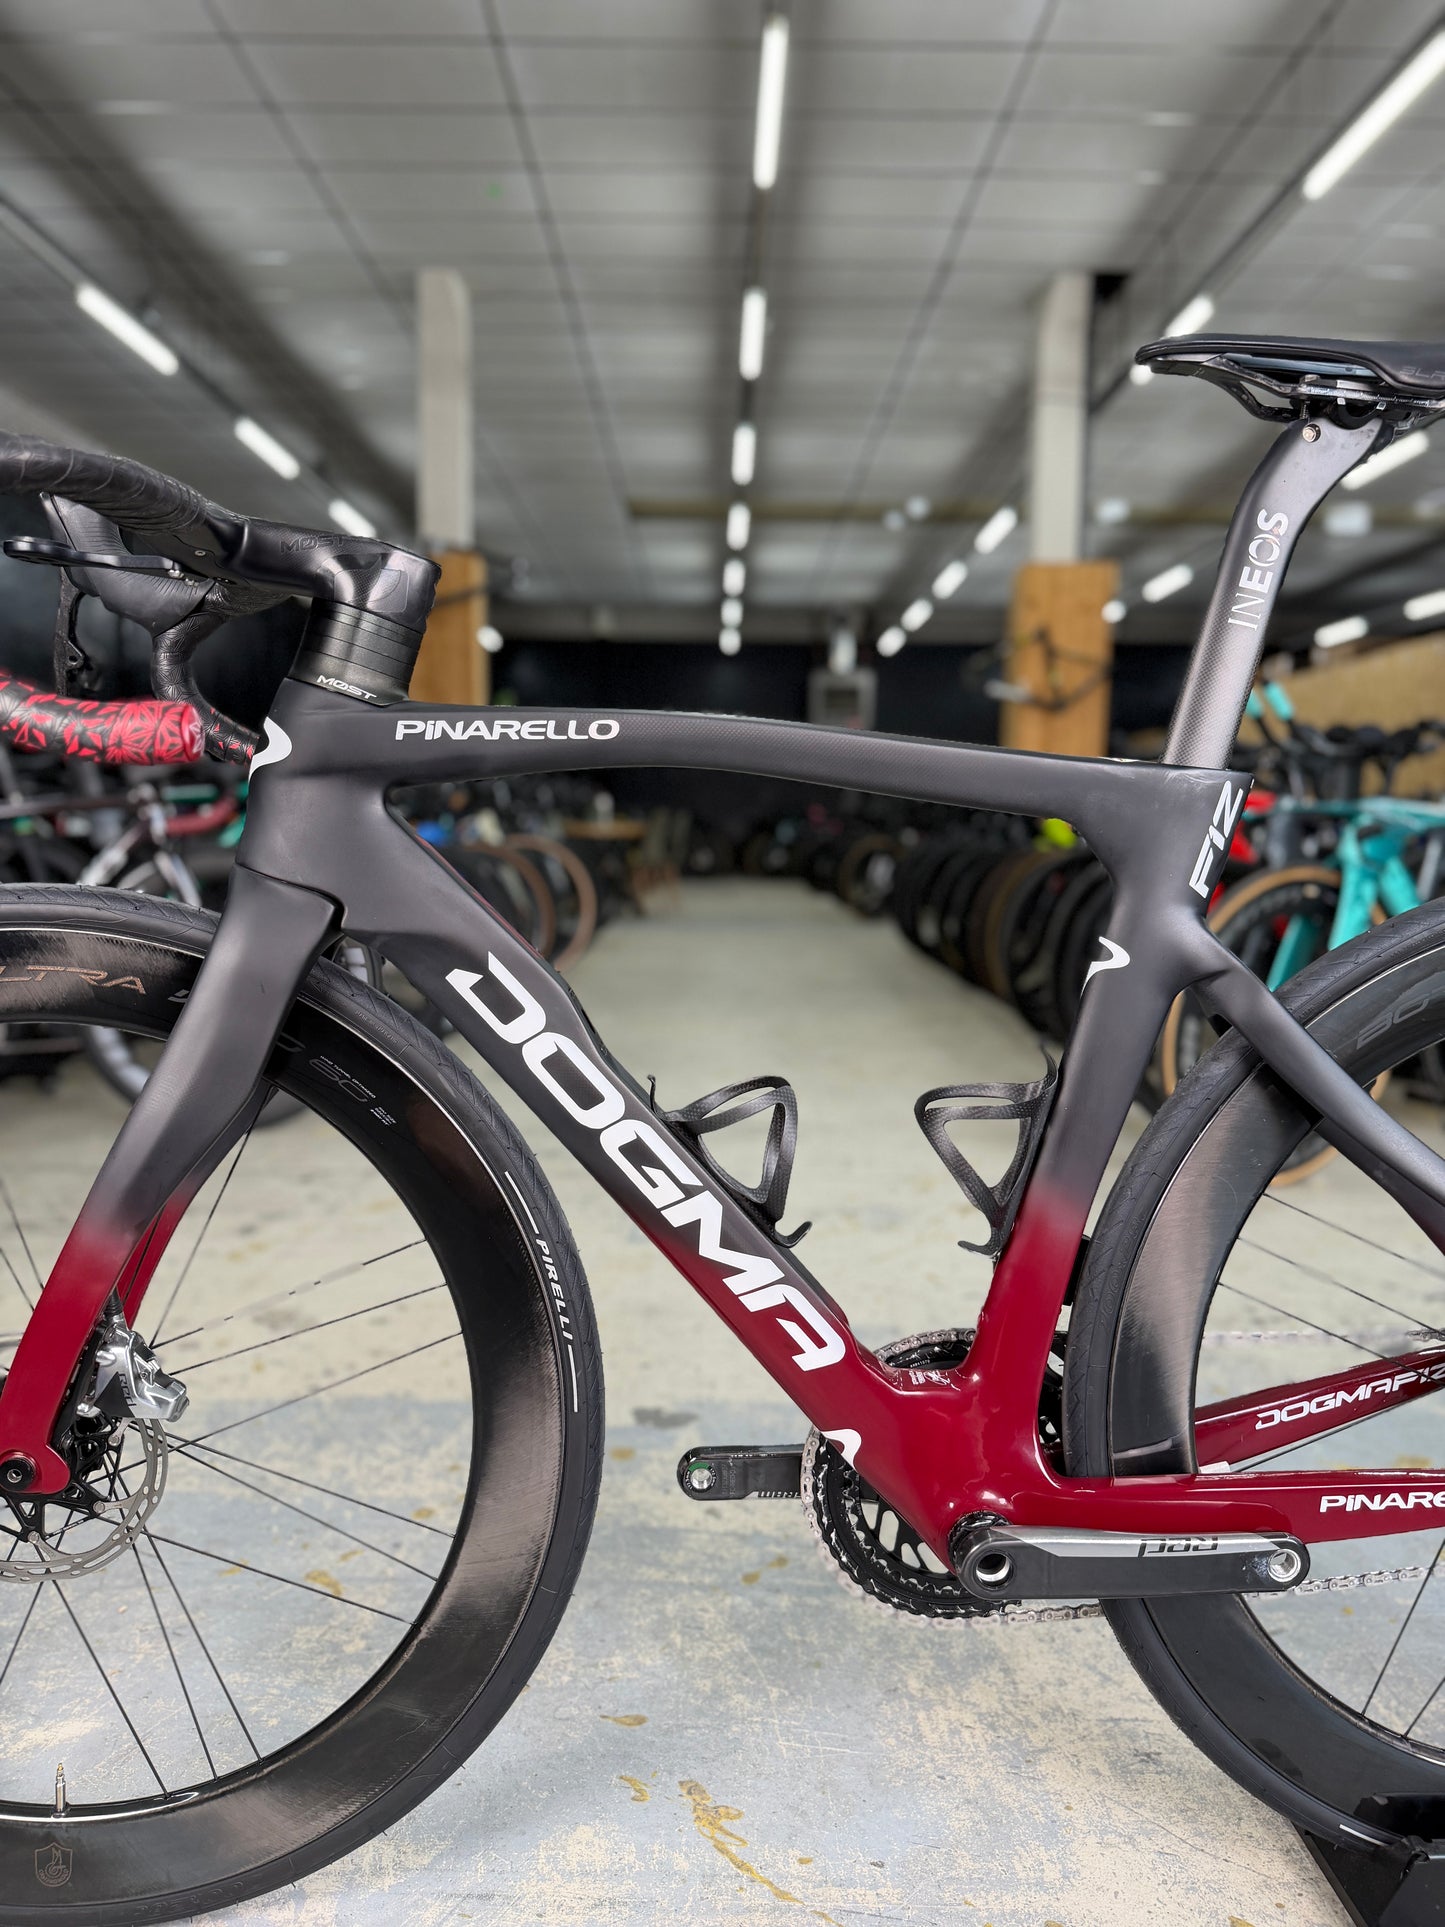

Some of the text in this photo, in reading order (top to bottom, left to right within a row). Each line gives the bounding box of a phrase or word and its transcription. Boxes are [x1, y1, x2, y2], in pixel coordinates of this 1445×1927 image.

[1228, 508, 1289, 631] INEOS
[445, 951, 846, 1371] DOGMA
[535, 1238, 574, 1341] PIRELLI
